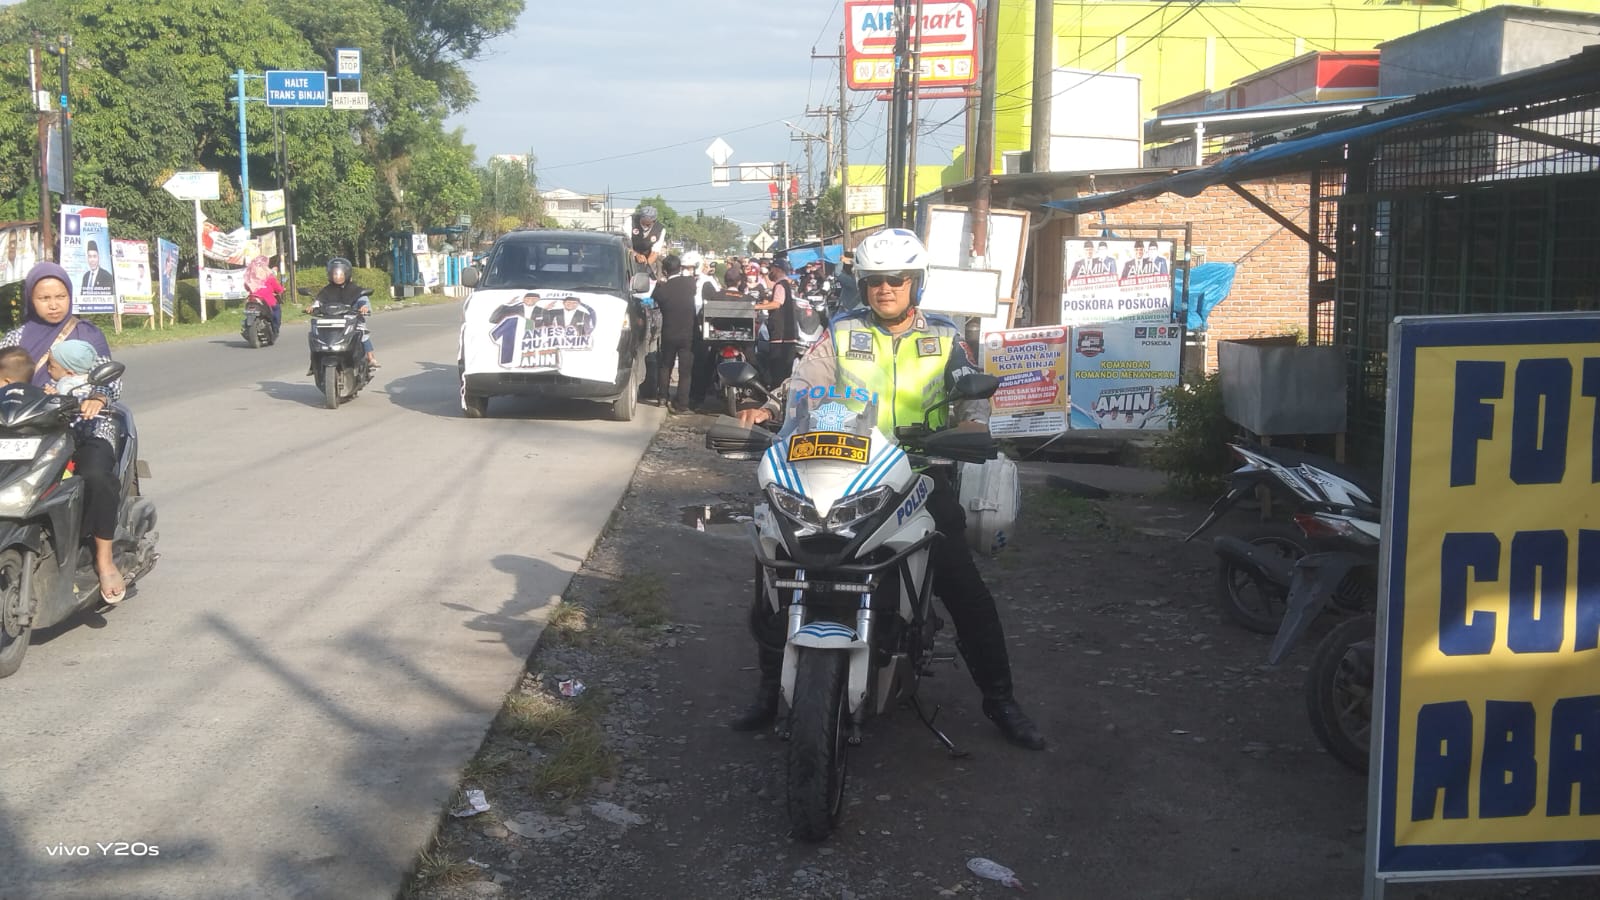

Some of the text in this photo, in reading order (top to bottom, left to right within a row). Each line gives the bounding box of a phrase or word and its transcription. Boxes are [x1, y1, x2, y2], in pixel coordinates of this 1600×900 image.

[862, 10, 965, 31] Alfmart
[340, 62, 358, 71] STOP
[284, 78, 309, 88] HALTE
[270, 90, 325, 100] TRANS BINJAI
[334, 96, 367, 105] HATI-HATI
[64, 236, 81, 245] PAN
[1078, 261, 1110, 277] AMIN
[1128, 261, 1162, 277] AMIN
[1064, 299, 1114, 311] POSKORA
[1118, 297, 1169, 310] POSKORA
[564, 326, 577, 336] &
[491, 316, 519, 365] 1
[1007, 344, 1048, 354] BAKORSI
[520, 353, 556, 367] AMIN
[992, 351, 1061, 362] RELAWAN AMIN
[1101, 360, 1150, 369] KOMANDAN
[1075, 370, 1176, 379] KOMANDO MENANGKAN
[795, 385, 879, 406] POLISI
[1096, 393, 1151, 412] AMIN
[838, 436, 847, 445] II
[817, 446, 842, 457] 1140
[851, 450, 864, 460] 30
[897, 480, 928, 526] POLISI
